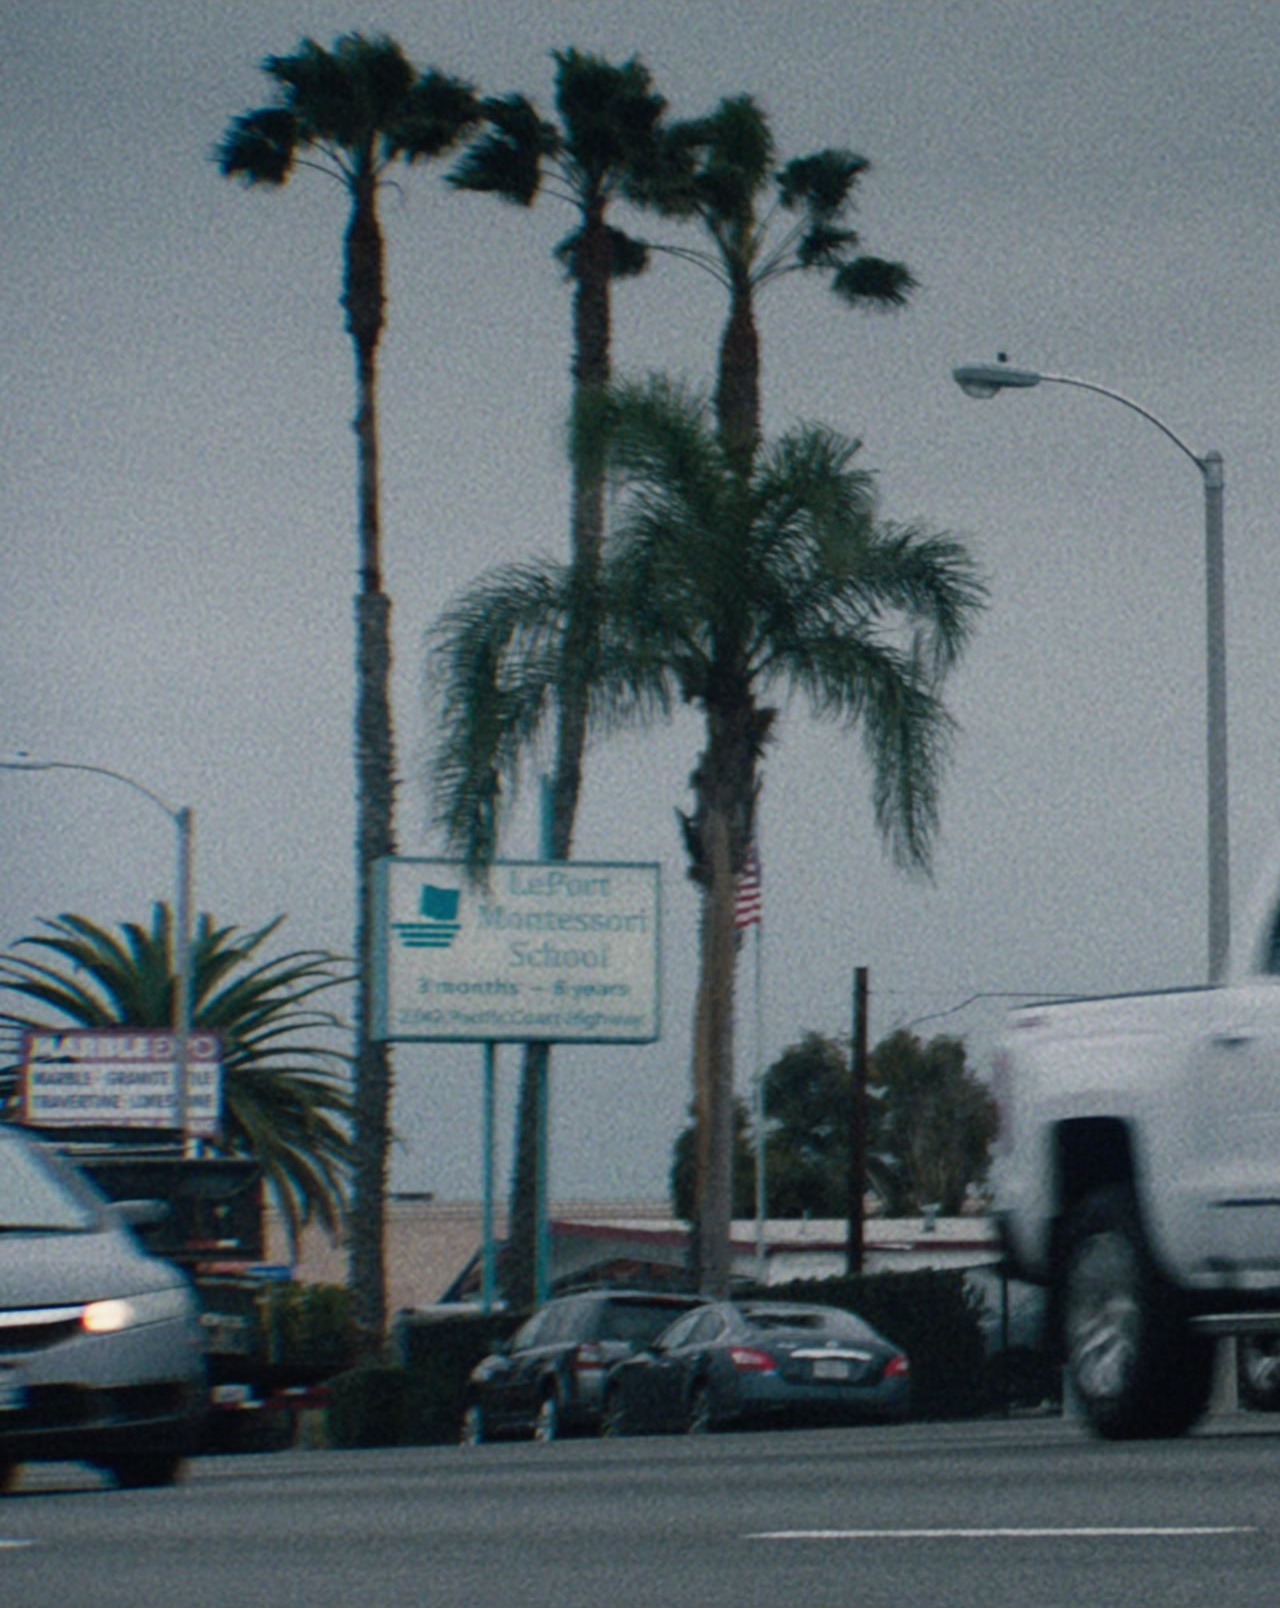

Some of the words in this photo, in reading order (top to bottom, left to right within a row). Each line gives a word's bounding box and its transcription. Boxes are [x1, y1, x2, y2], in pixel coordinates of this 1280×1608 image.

[508, 870, 609, 897] LePort
[477, 904, 648, 933] Montessori
[508, 941, 609, 968] School
[435, 977, 519, 996] months
[569, 983, 630, 999] years
